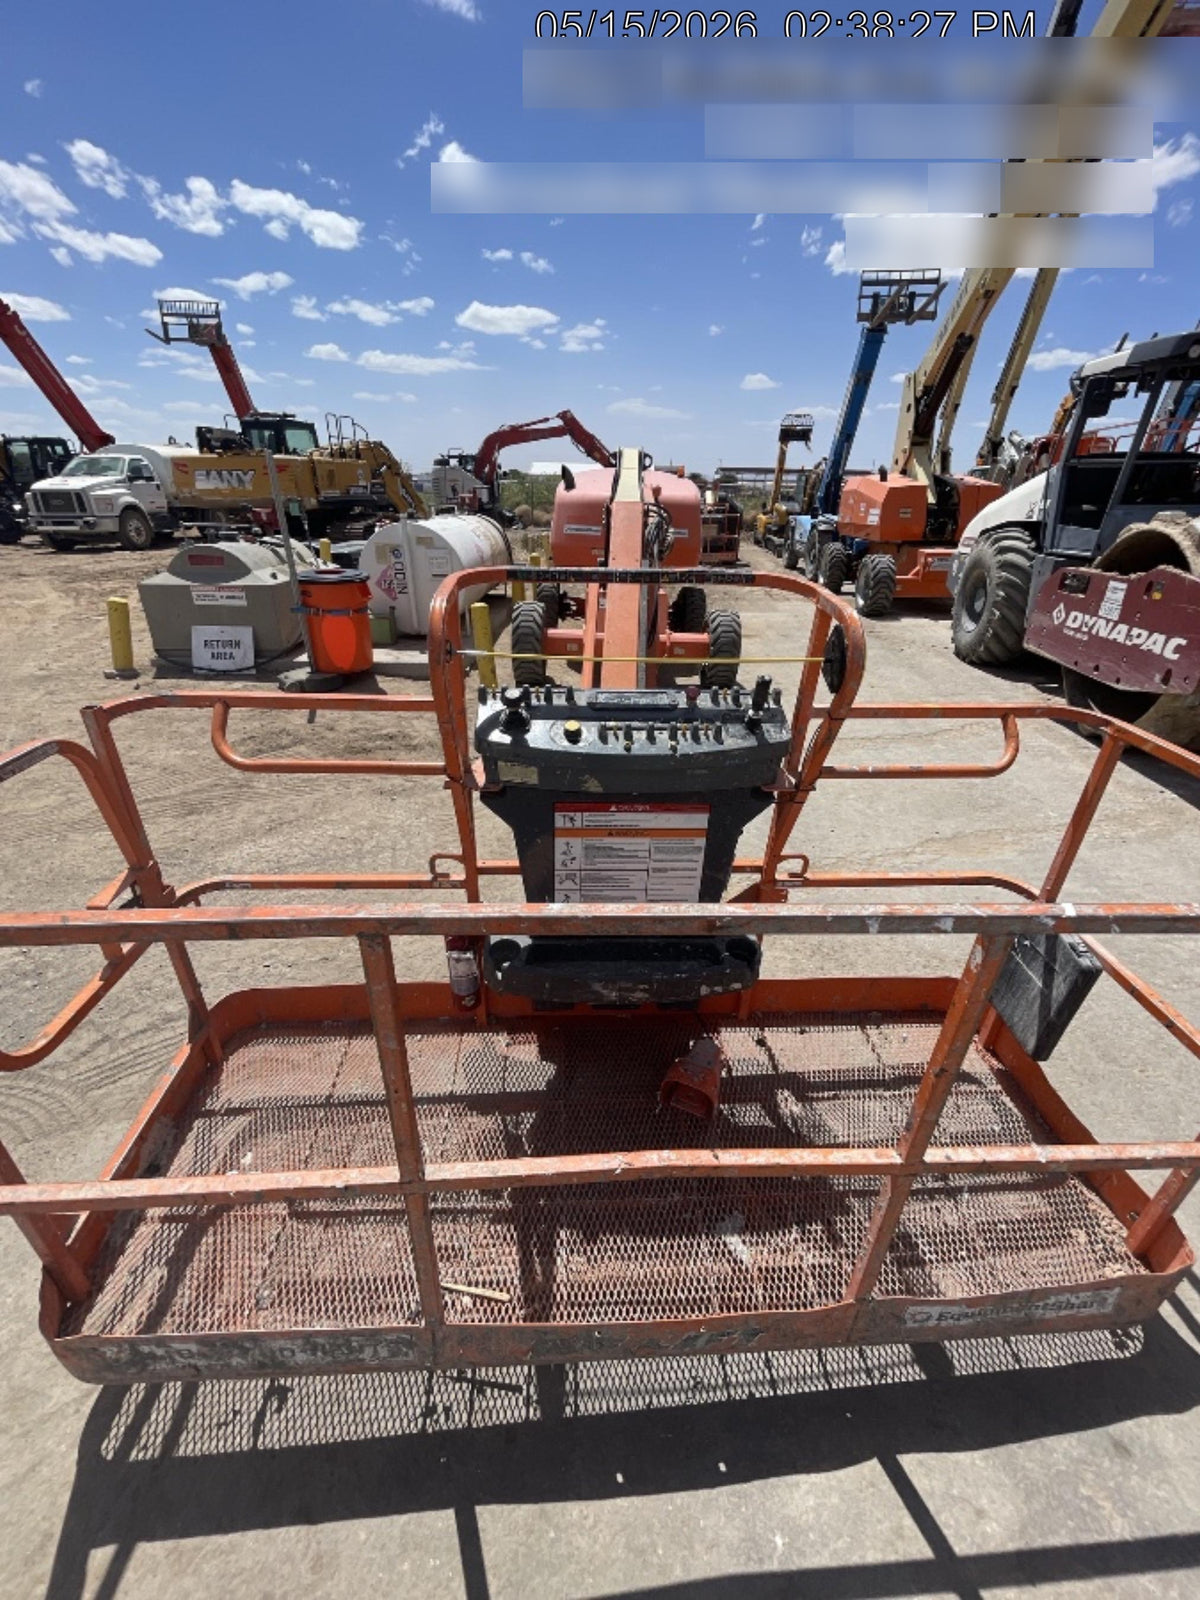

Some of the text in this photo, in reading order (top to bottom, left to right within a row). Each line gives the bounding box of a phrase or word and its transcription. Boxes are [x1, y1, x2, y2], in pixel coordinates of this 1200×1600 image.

[1065, 610, 1188, 660] DYNAPAC
[203, 639, 241, 650] RETURN
[211, 651, 235, 661] AREA
